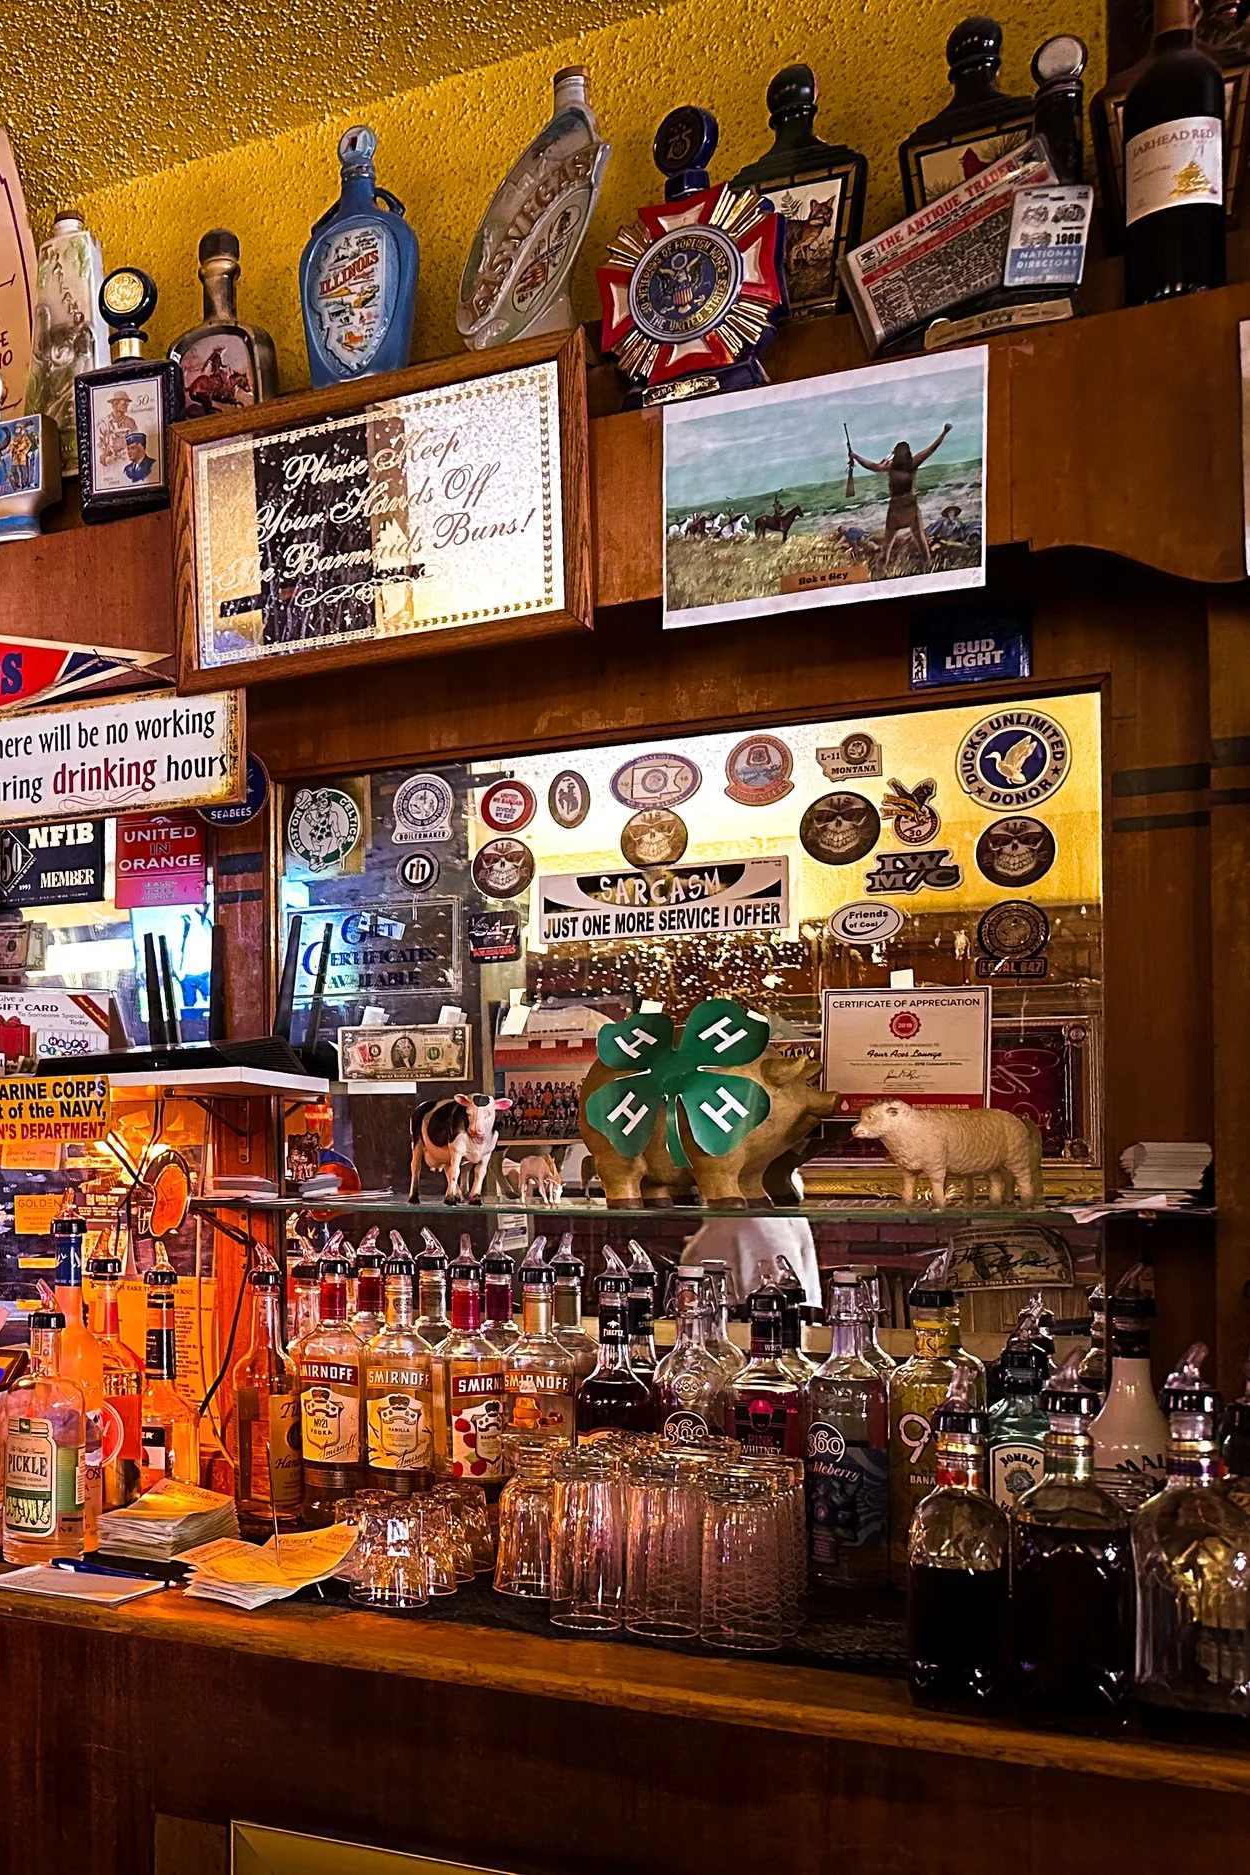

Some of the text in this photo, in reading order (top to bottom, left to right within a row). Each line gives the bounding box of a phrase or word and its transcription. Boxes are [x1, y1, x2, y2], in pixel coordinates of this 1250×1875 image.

[1133, 127, 1215, 157] JARHEAD RED
[879, 158, 1018, 253] THE ANTIQUE TRADER
[1017, 259, 1077, 268] DIRECTORY
[1020, 250, 1078, 259] NATIONAL
[320, 250, 379, 295] ILLINOIS
[669, 280, 728, 331] UNITED STATES
[282, 428, 461, 491] Please Keep
[255, 461, 500, 543] Your Hands Off
[433, 508, 535, 550] Buns!
[953, 639, 995, 655] BUD
[945, 650, 1004, 669] LIGHT
[39, 722, 72, 752] will
[78, 719, 100, 746] be
[105, 719, 129, 743] no
[136, 706, 217, 746] working
[820, 752, 840, 761] L-11
[961, 712, 1066, 785] DUCKS UNLIMITED
[52, 754, 156, 798] drinking
[165, 751, 227, 783] hours
[831, 764, 876, 775] MONTANA
[989, 778, 1053, 805] DONOR
[211, 806, 252, 819] SEABEES
[339, 798, 358, 843] CELTICS
[28, 822, 94, 849] NFIB
[124, 826, 197, 843] UNITED
[398, 831, 447, 840] BOILERMAKER
[150, 842, 171, 855] IN
[118, 854, 202, 871] ORANGE
[39, 869, 95, 889] MEMBER
[600, 868, 721, 906] SARCASM
[544, 903, 781, 940] JUST ONE MORE SERVICE I OFFER
[849, 908, 889, 920] Friends
[859, 920, 878, 928] Coal
[25, 1004, 58, 1012] CARD
[833, 1001, 891, 1009] CERTIFICATE
[910, 998, 980, 1007] APPRECIATION
[49, 1037, 88, 1049] HAPPY
[867, 1050, 942, 1058] Four Aces Lounge
[52, 1079, 107, 1098] CORPS
[9, 1103, 23, 1118] of
[28, 1102, 55, 1117] the
[59, 1099, 107, 1118] NAVY,
[20, 1120, 106, 1140] DEPARTMENT
[18, 1198, 62, 1208] GOLDEN
[603, 1328, 624, 1337] FIREFLY
[368, 1368, 430, 1387] SMIRNOFF
[747, 1434, 774, 1446] PINK
[807, 1427, 842, 1456] 360
[742, 1445, 782, 1455] WHITNEY
[8, 1454, 47, 1477] PICKLE
[1000, 1453, 1039, 1469] BOMBAY
